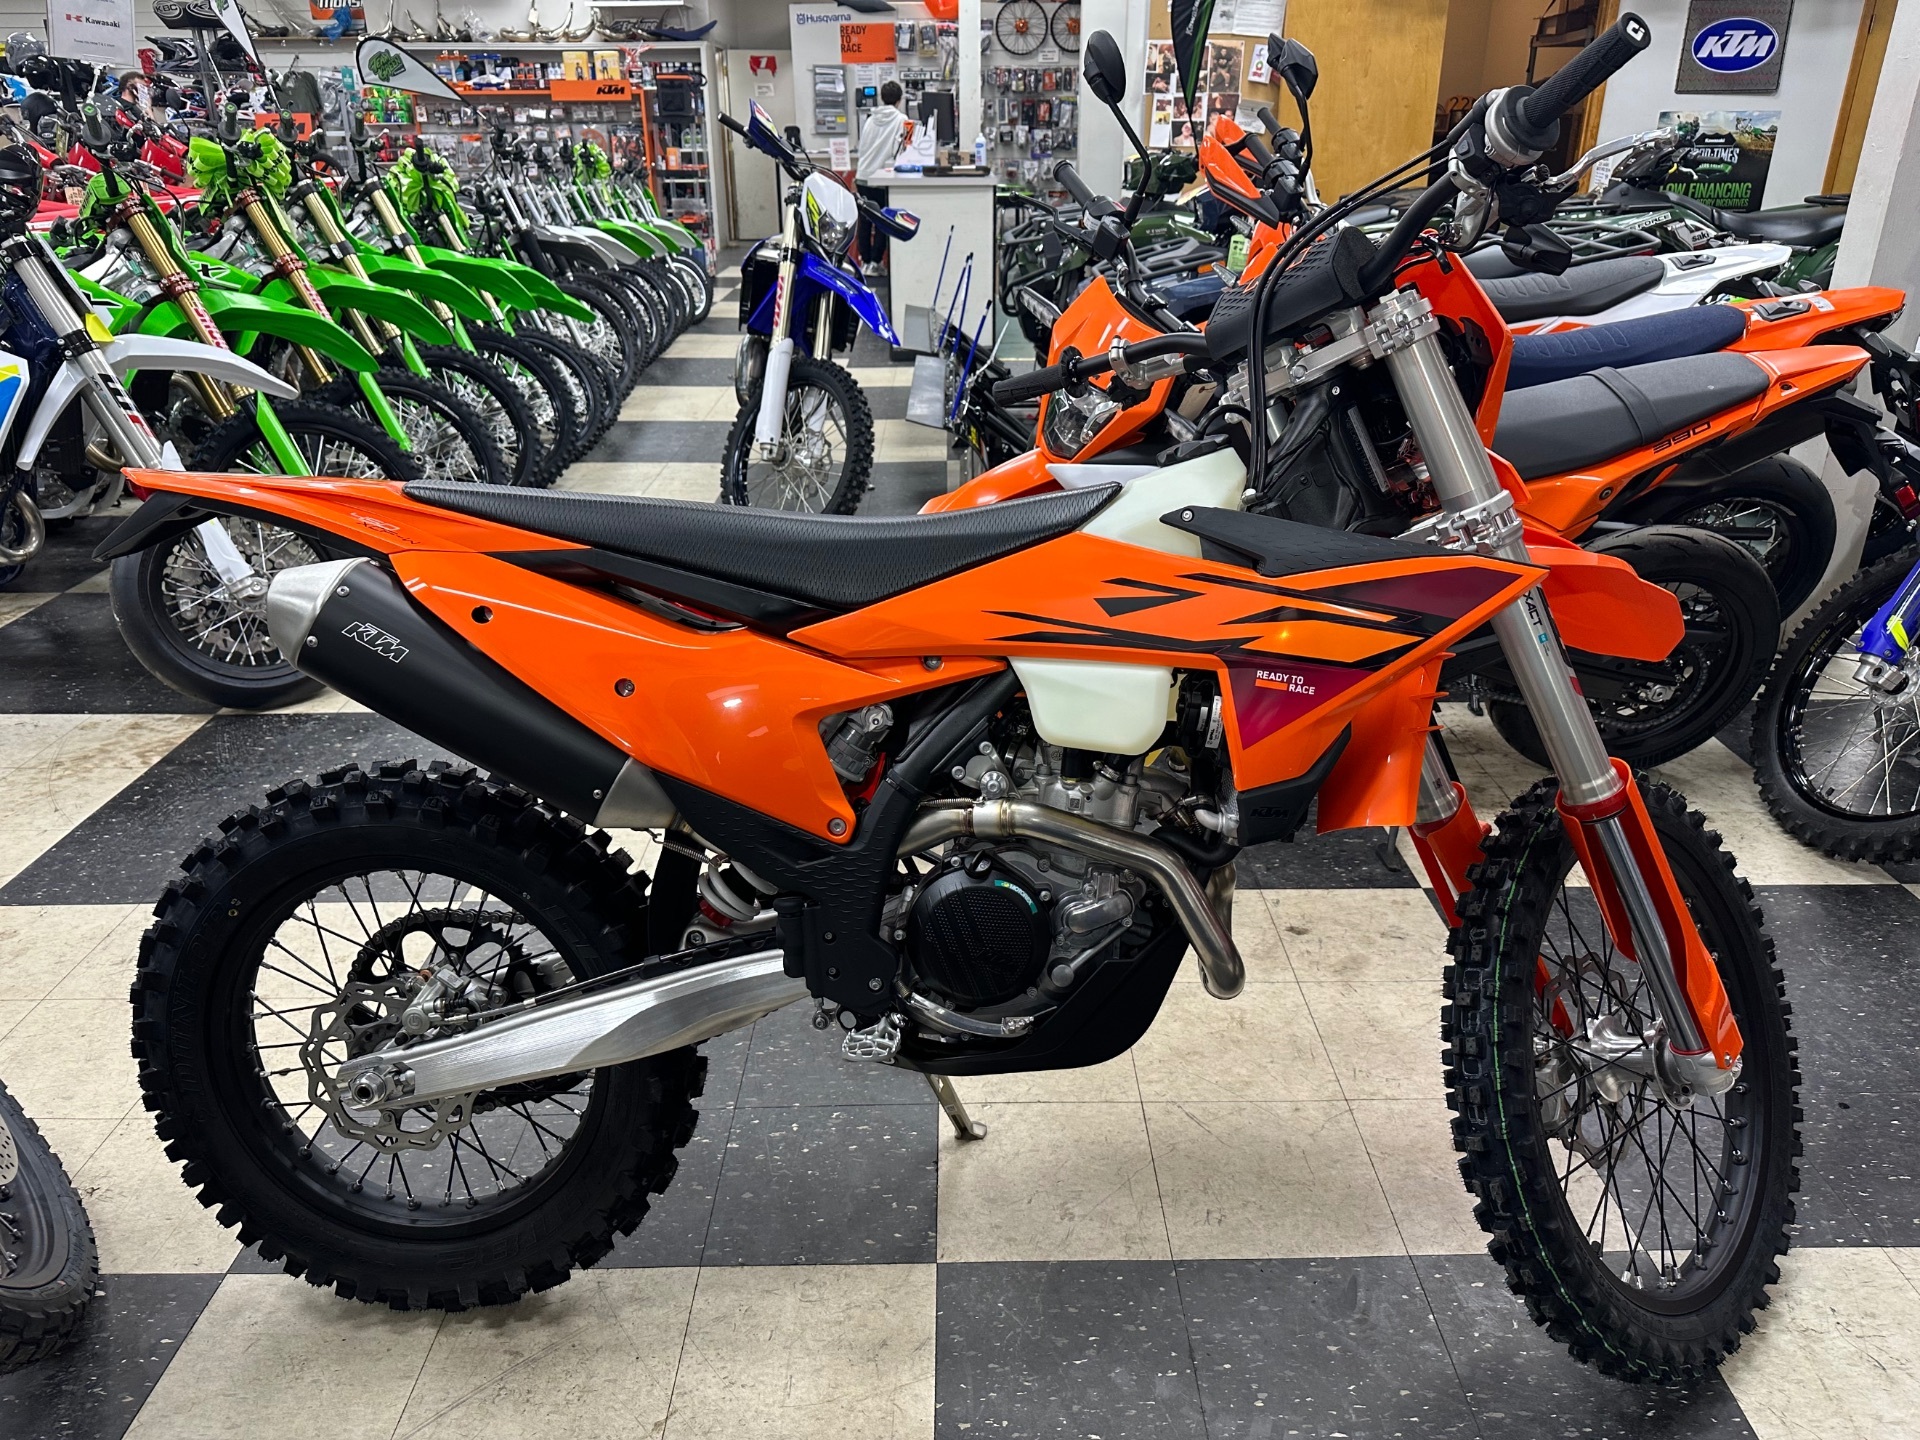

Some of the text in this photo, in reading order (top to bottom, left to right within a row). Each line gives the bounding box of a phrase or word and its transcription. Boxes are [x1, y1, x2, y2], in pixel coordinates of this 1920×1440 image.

[155, 4, 178, 12] KBC
[85, 17, 121, 28] Kawasaki
[806, 13, 851, 23] Husqvarna
[840, 25, 867, 35] READY
[841, 35, 851, 44] TO
[1696, 29, 1774, 58] KTM
[841, 44, 862, 53] RACE
[596, 84, 625, 95] KTM
[1688, 182, 1752, 198] FINANCING
[1716, 199, 1750, 207] INCENTIVES
[1637, 213, 1670, 229] FORCE
[1652, 421, 1711, 454] 390
[1523, 590, 1543, 626] XACT
[341, 621, 409, 663] KTM
[1256, 670, 1304, 684] READY TO
[1289, 683, 1316, 695] RACE
[1250, 806, 1289, 820] KTM
